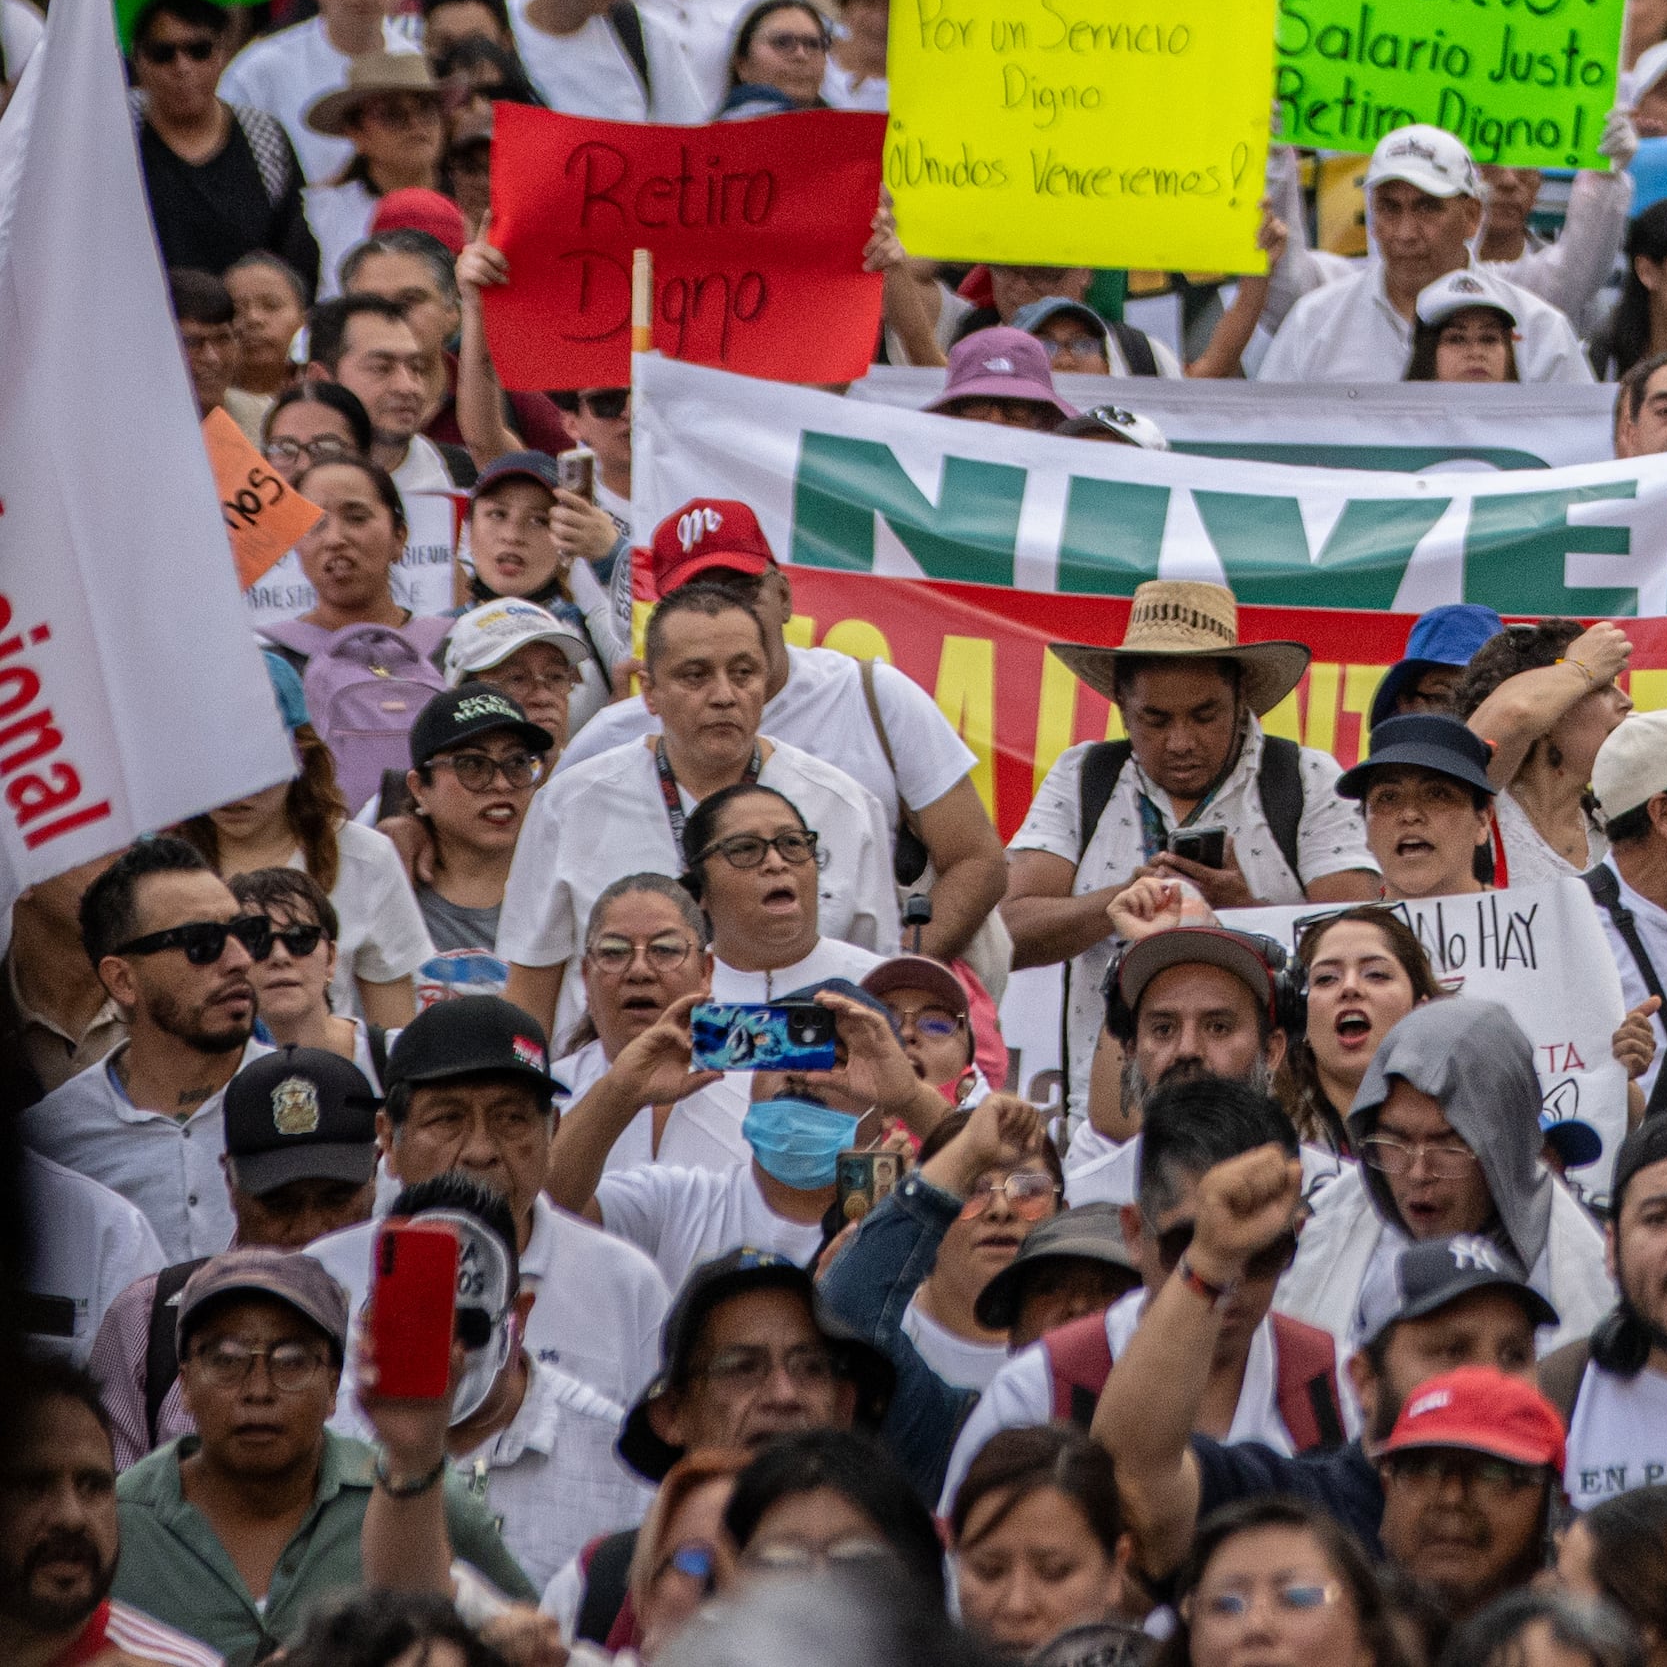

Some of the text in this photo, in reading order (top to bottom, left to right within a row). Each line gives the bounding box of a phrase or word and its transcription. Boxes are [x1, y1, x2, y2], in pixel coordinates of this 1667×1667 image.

[991, 19, 1027, 53] un
[1488, 24, 1604, 88] Justo
[1000, 62, 1102, 130] Digno
[564, 140, 774, 228] Retiro
[559, 248, 768, 362] Dgno
[1477, 902, 1540, 973] HAY
[1578, 1466, 1627, 1494] EN
